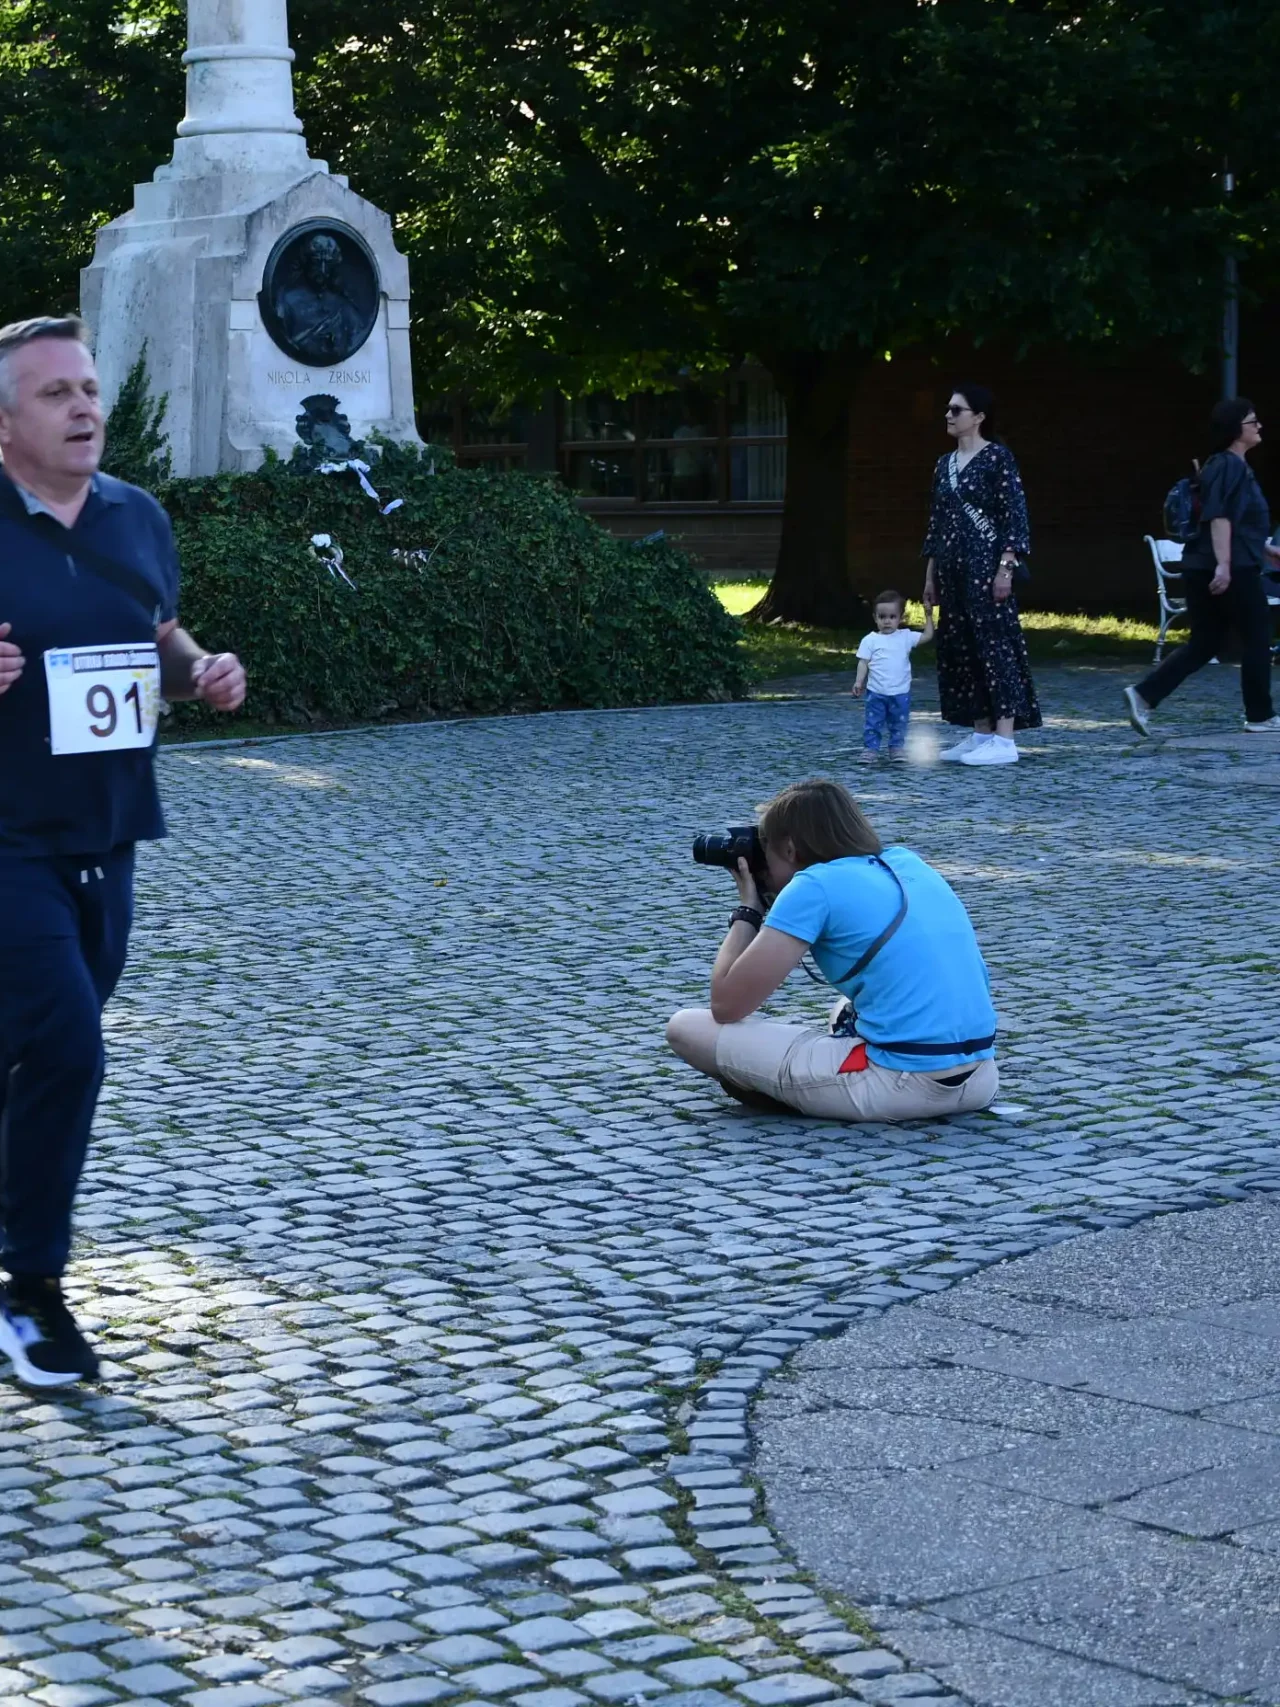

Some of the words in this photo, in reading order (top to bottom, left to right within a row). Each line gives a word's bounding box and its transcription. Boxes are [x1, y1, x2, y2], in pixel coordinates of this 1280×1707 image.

[267, 371, 311, 384] NIKOLA
[328, 370, 372, 384] ZRINSKI
[86, 681, 143, 738] 91
